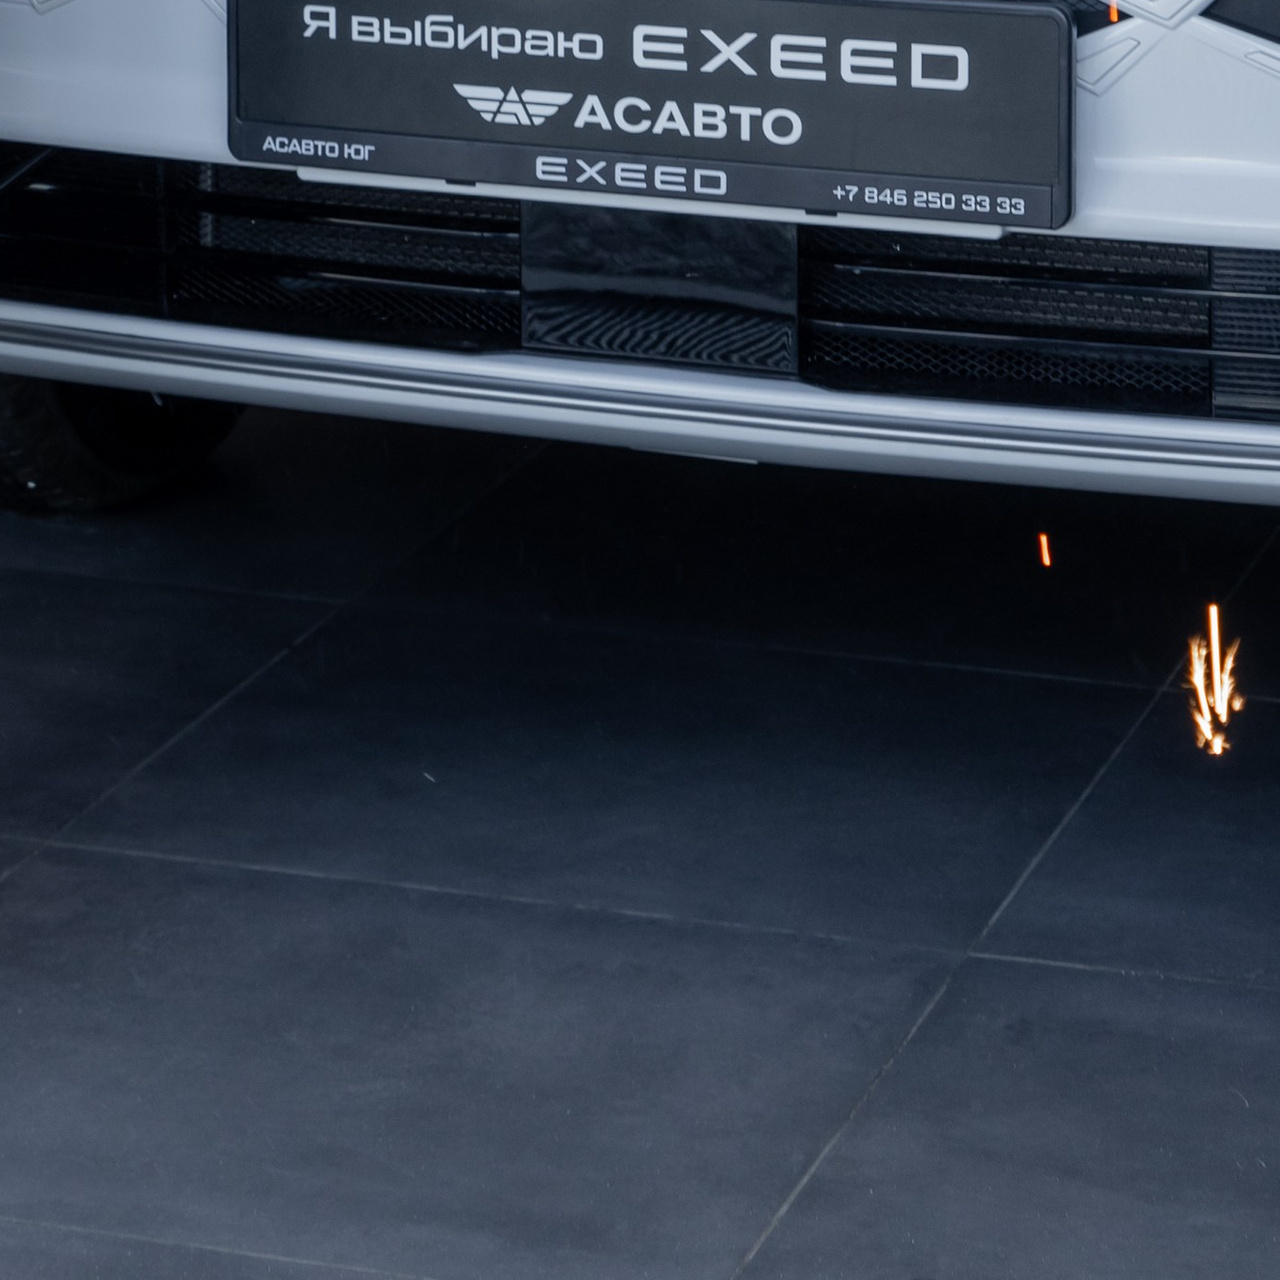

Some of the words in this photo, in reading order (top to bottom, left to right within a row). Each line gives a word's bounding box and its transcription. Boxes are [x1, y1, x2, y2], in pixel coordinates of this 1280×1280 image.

[304, 5, 336, 38] Я
[352, 15, 604, 60] выбираю
[633, 25, 969, 91] EXEED
[574, 94, 803, 145] АСАВТО
[263, 136, 339, 157] АСАВТО
[344, 143, 376, 160] ЮГ
[536, 156, 727, 195] EXEED
[833, 185, 858, 201] +7
[865, 187, 908, 205] 846
[914, 190, 956, 209] 250
[962, 194, 991, 212] 33
[997, 197, 1025, 215] 33
